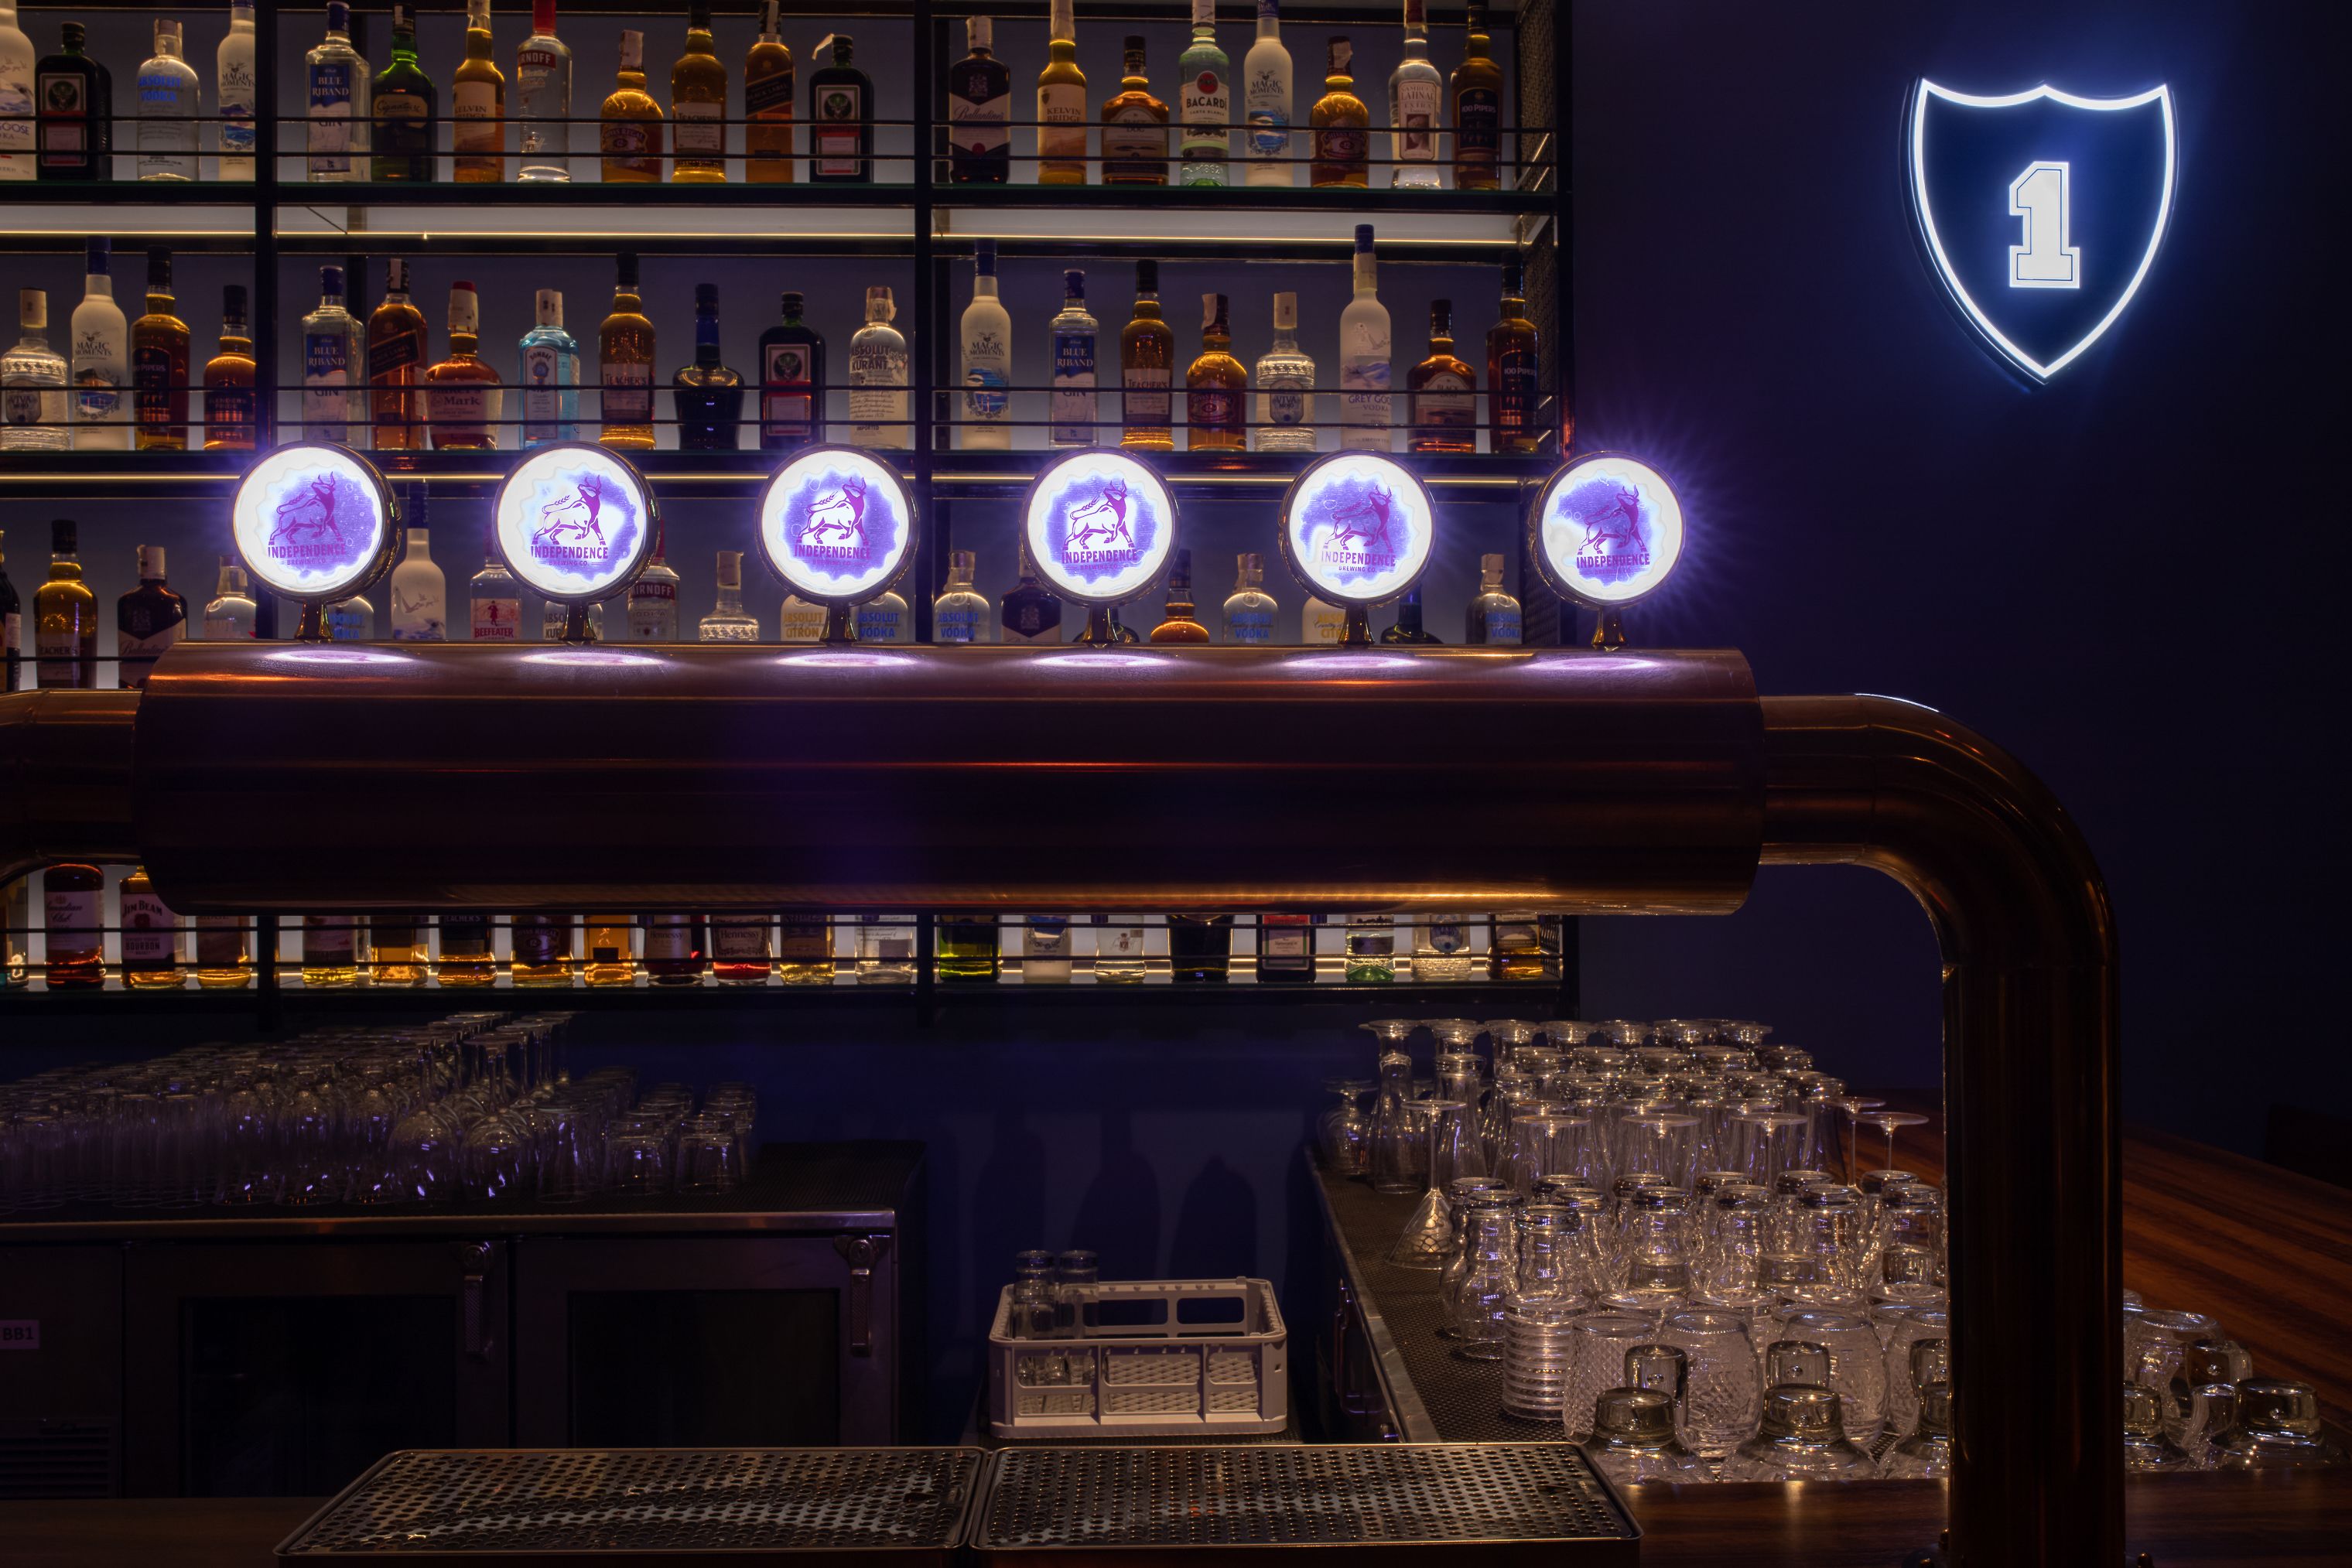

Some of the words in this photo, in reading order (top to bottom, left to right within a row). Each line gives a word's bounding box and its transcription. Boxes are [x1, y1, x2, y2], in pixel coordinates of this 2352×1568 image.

[318, 77, 342, 85] BLUE
[141, 90, 176, 102] VODKA
[312, 87, 349, 97] RIBAND
[1186, 97, 1227, 110] BACARDÍ
[1474, 104, 1496, 113] PIPERS
[1047, 107, 1081, 115] KELVIN
[0, 122, 31, 136] OOSE
[2009, 161, 2080, 289] 1
[314, 347, 339, 355] BLUE
[851, 345, 890, 356] ABSOLUT
[1063, 347, 1087, 357] BLUE
[309, 357, 345, 367] RIBAND
[852, 360, 888, 371] KURANT
[1057, 358, 1093, 367] RIBAND
[606, 374, 646, 384] TEACHER'S
[1127, 379, 1167, 388] TEACHER'S
[444, 396, 481, 405] Mark
[1349, 394, 1373, 403] GREY
[268, 543, 346, 558] INDEPENDENCE
[531, 545, 608, 559] INDEPENDENCE
[795, 545, 870, 560] INDEPENDENCE
[1062, 549, 1137, 564] INDEPENDENCE
[1321, 551, 1396, 566] INDEPENDENCE
[1577, 553, 1649, 568] INDEPENDENCE
[784, 612, 823, 623] ABSOLUT
[857, 612, 899, 623] ABSOLUT
[938, 612, 978, 623] ABSOLUT
[1231, 613, 1273, 624] ABSOLUT
[474, 627, 514, 638] BEEFEATER
[786, 627, 819, 637] CITRON
[860, 627, 894, 637] VODKA
[941, 627, 974, 638] VODKA
[1236, 628, 1269, 638] VODKA
[122, 904, 137, 918] JIM
[139, 900, 162, 917] BEAM
[650, 929, 682, 940] Hennessy
[720, 930, 759, 940] Hennessy
[125, 941, 160, 951] BOURBON
[3, 1326, 34, 1341] BB1
